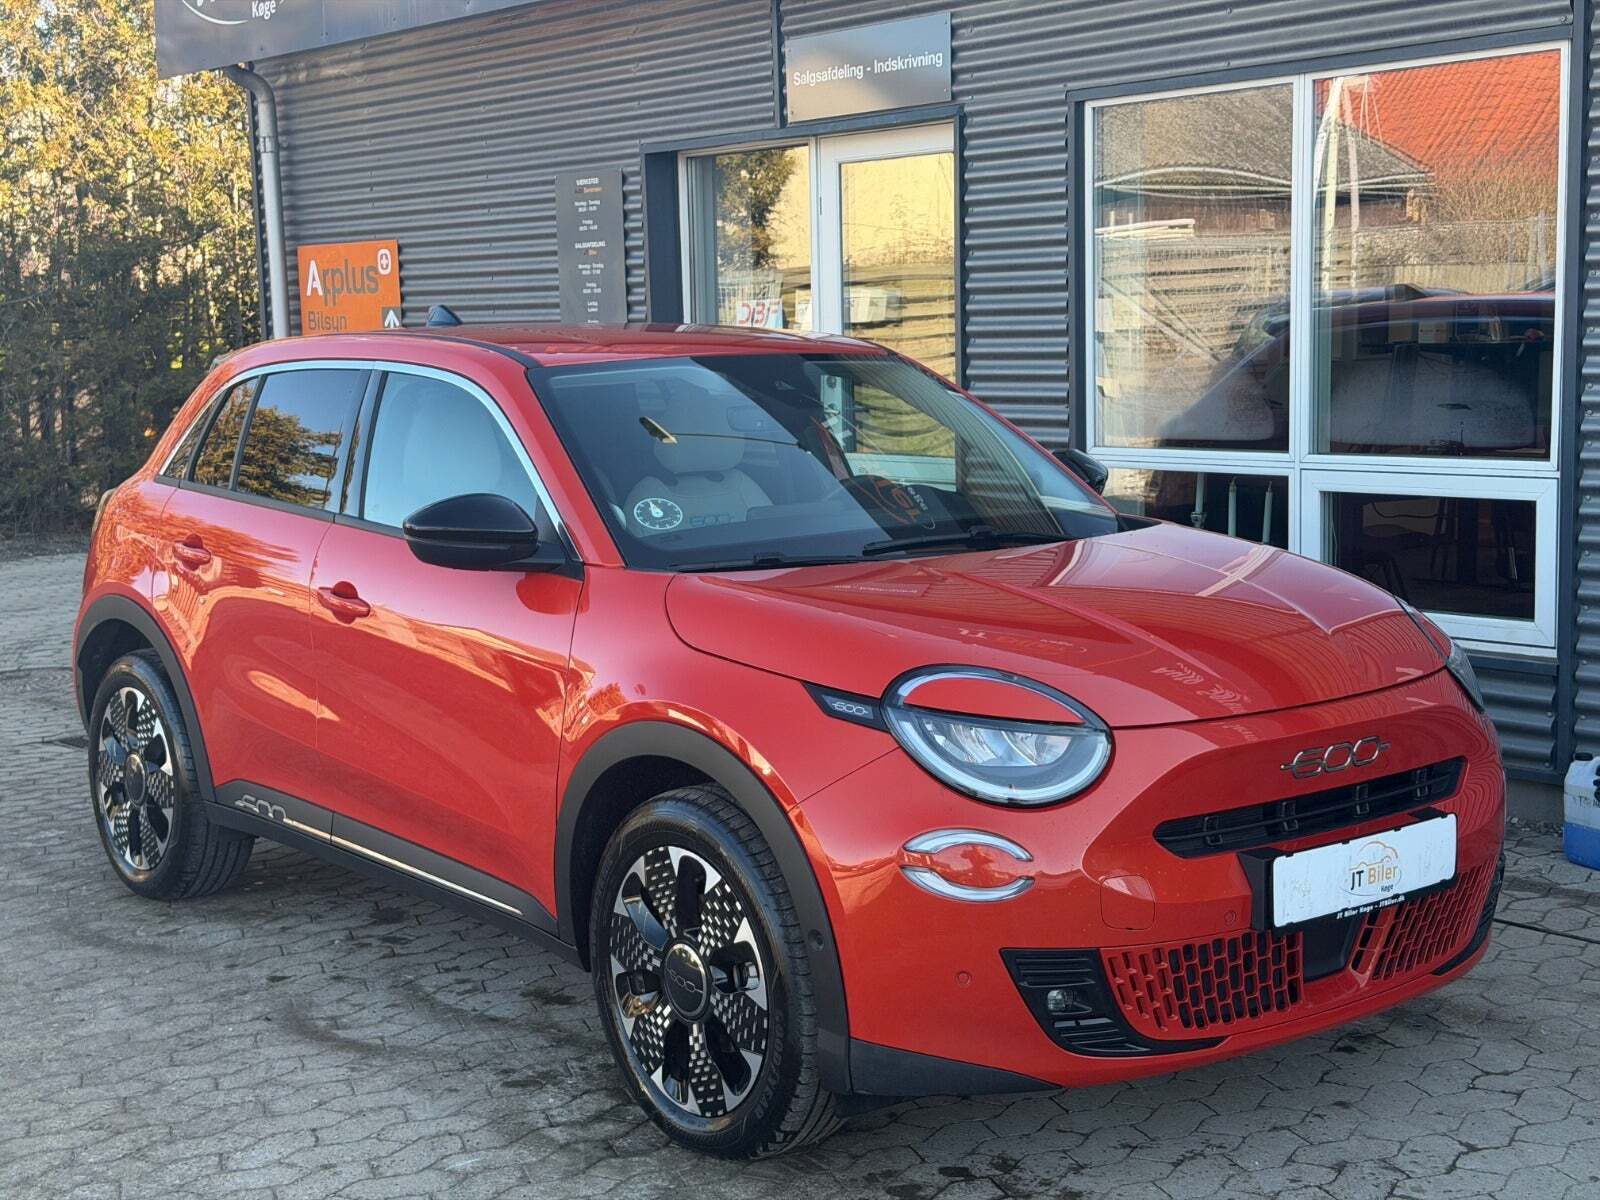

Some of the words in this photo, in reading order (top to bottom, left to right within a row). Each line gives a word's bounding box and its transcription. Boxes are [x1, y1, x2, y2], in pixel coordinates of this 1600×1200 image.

[251, 0, 277, 20] Køge
[793, 64, 864, 87] Salgsafdeling
[874, 51, 943, 73] Indskrivning
[307, 311, 348, 332] Bilsyn
[832, 701, 868, 716] 600
[1281, 736, 1391, 780] 600
[1350, 869, 1365, 891] JT
[1367, 863, 1399, 885] Biler
